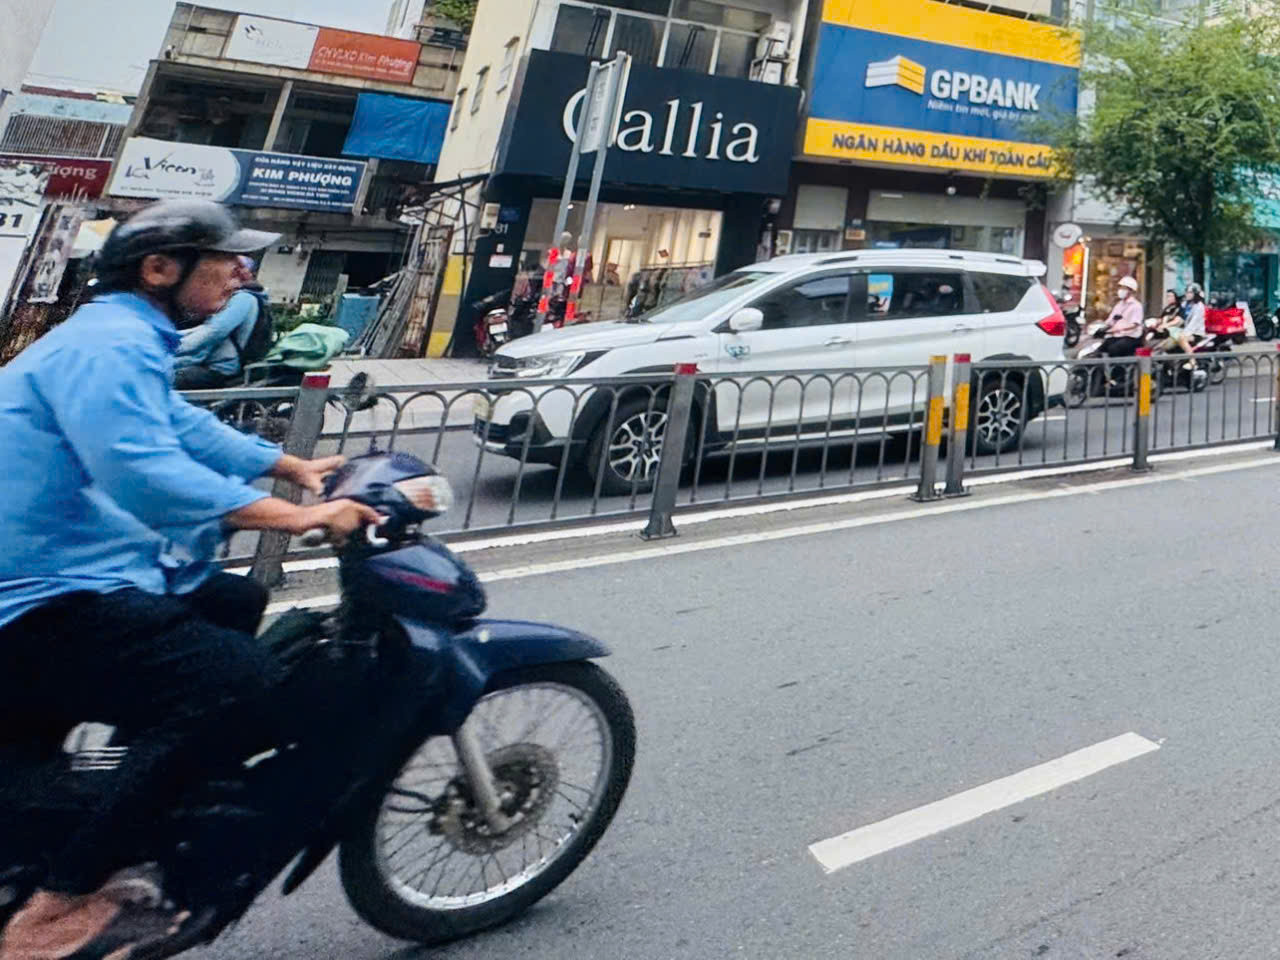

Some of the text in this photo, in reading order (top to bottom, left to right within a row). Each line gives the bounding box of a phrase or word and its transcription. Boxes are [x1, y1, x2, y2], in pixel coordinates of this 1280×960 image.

[930, 69, 1041, 111] GPBANK
[832, 133, 879, 153] NGÂN
[882, 135, 926, 158] HÀNG
[930, 141, 960, 161] DẦU
[962, 146, 987, 162] KHÍ
[990, 148, 1025, 168] TOÀN
[252, 167, 353, 187] KIM PHƯỢNG
